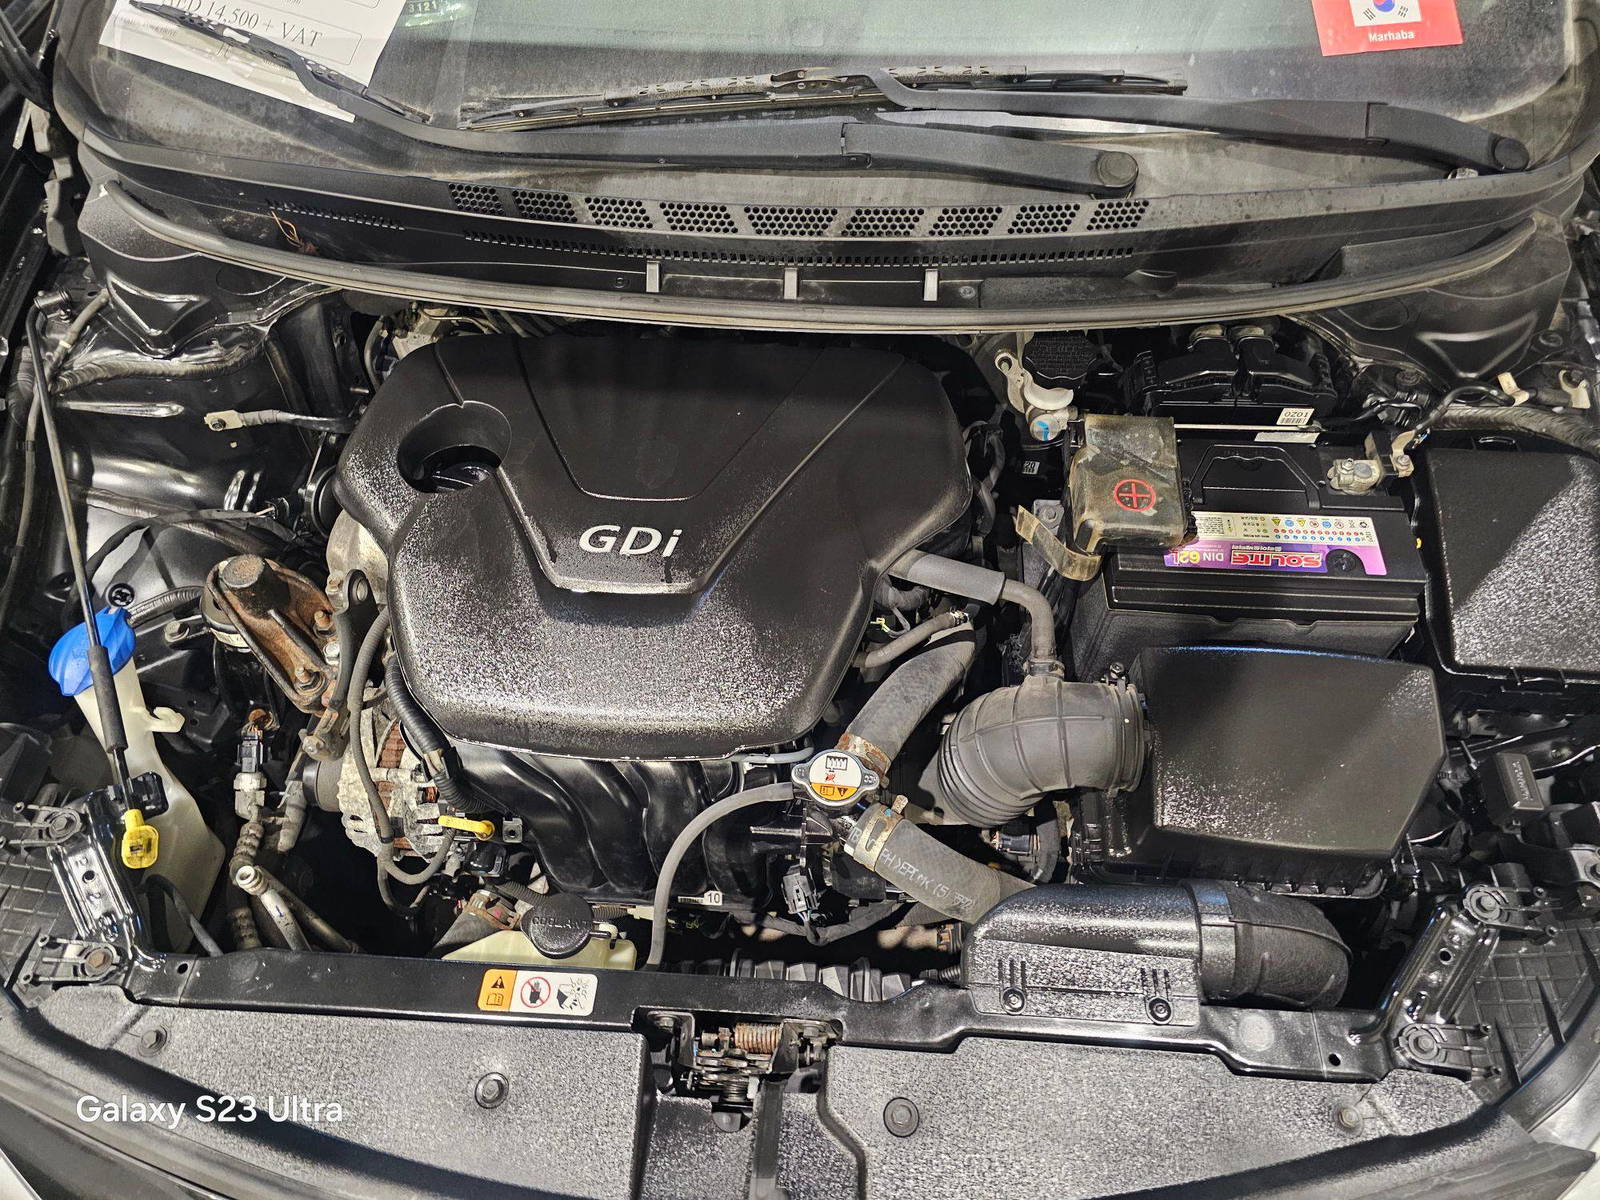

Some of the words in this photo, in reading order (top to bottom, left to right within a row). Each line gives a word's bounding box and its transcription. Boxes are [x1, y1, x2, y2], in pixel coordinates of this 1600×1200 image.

[204, 0, 259, 30] 14,500
[281, 24, 323, 47] VAT
[1367, 30, 1415, 43] Marhaba
[578, 525, 682, 558] GDi
[1202, 551, 1225, 563] DIN
[1230, 552, 1322, 569] SOLITE
[707, 892, 721, 905] 10
